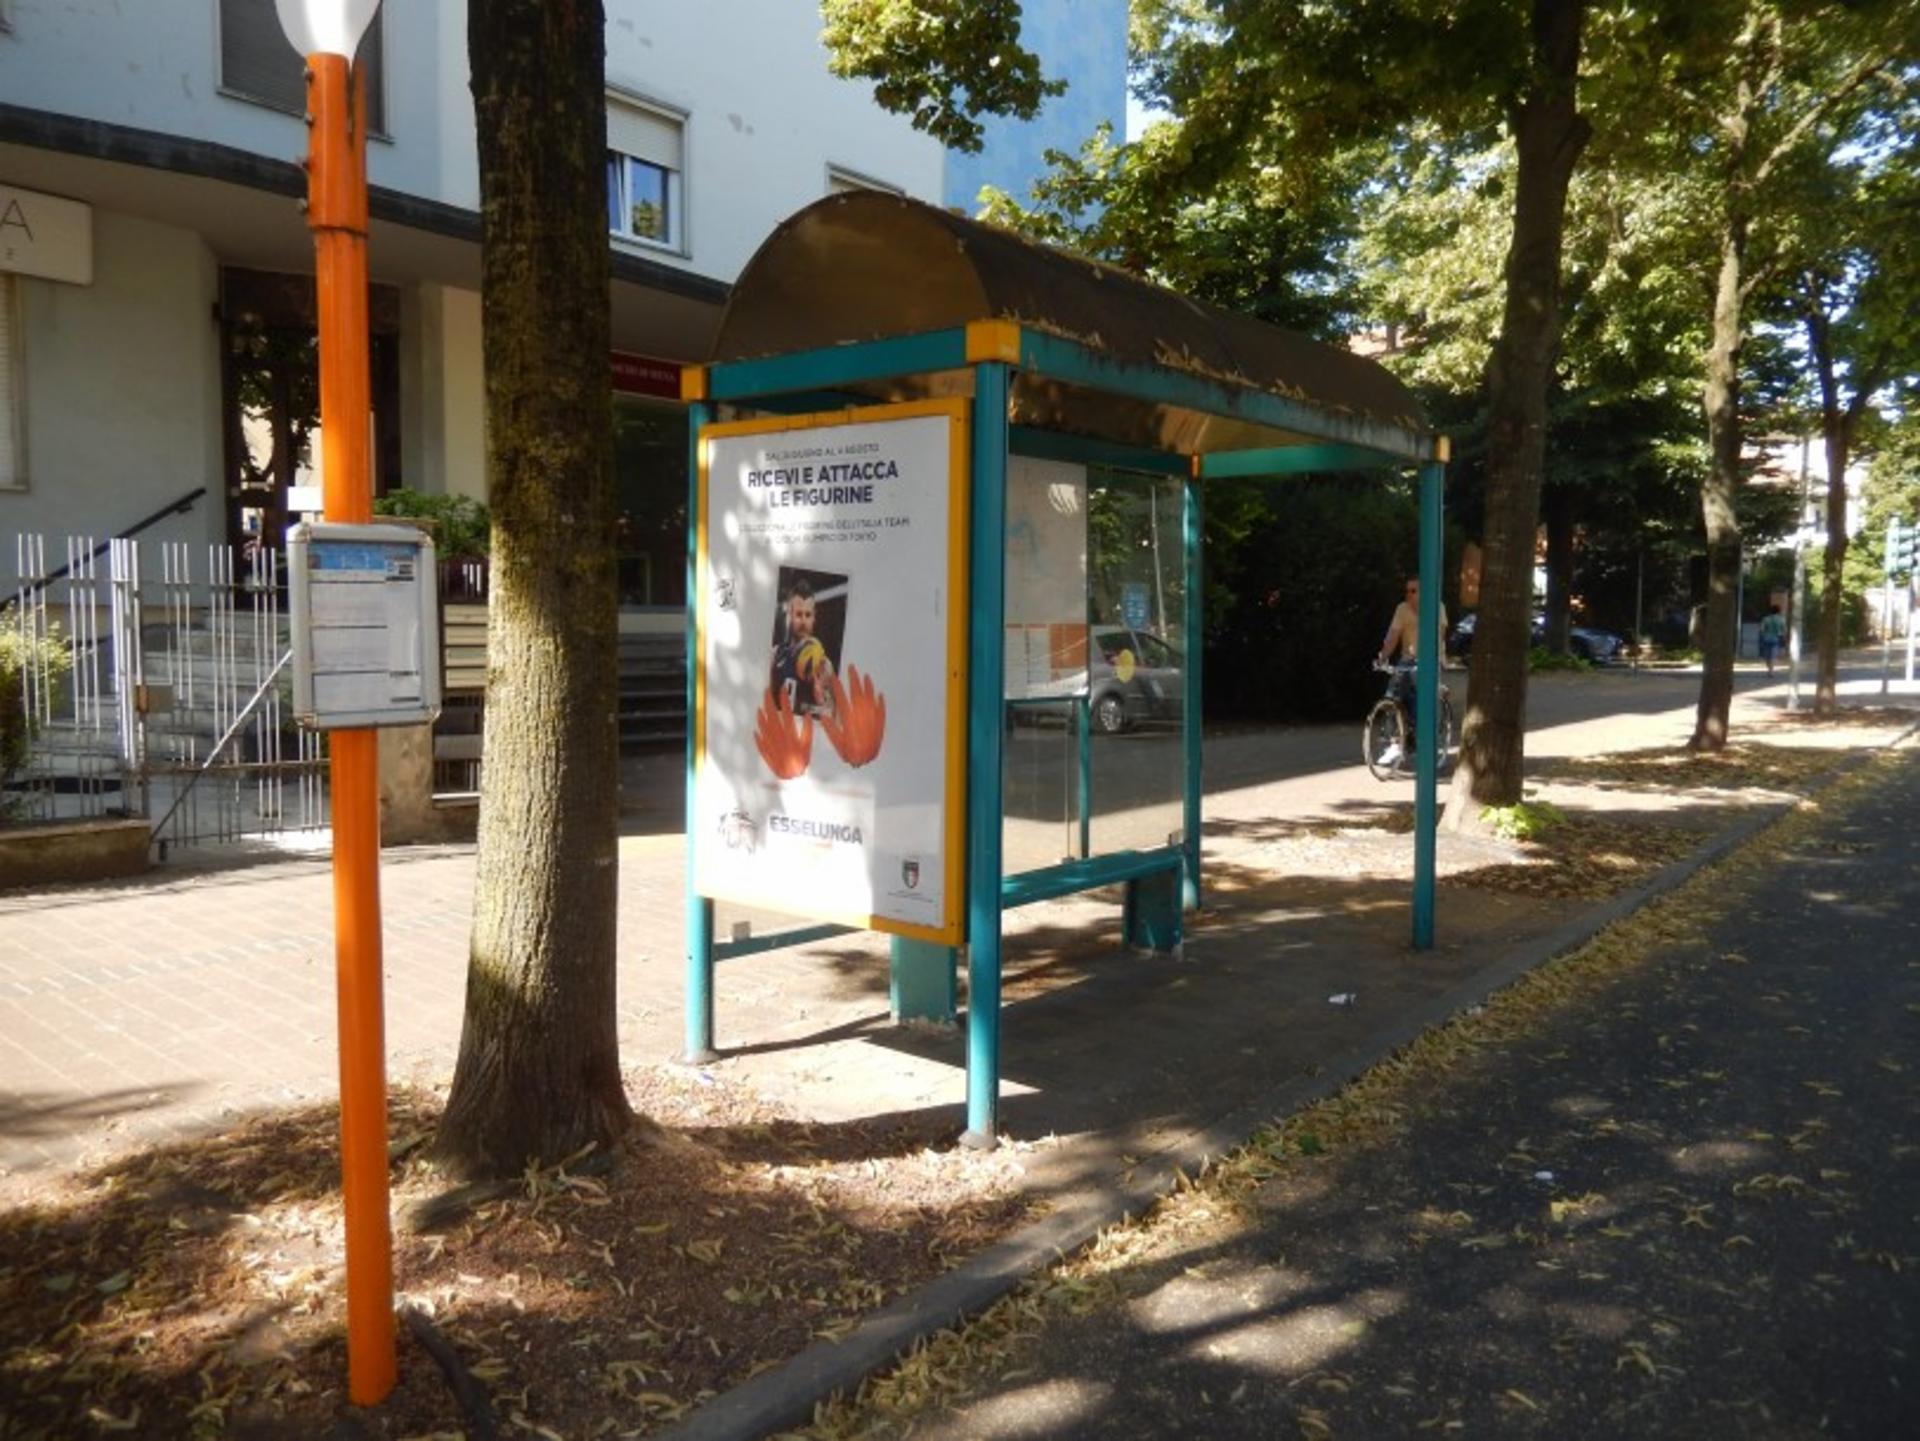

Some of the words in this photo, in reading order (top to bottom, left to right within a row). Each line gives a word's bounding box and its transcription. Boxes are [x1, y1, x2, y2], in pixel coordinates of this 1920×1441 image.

[748, 467, 799, 487] RICEVI
[802, 466, 813, 485] E
[818, 460, 899, 482] ATTACCA
[770, 490, 790, 508] LE
[793, 485, 874, 507] FIGURINE
[884, 516, 910, 528] TEAM
[769, 815, 863, 844] ESSELUNGA
